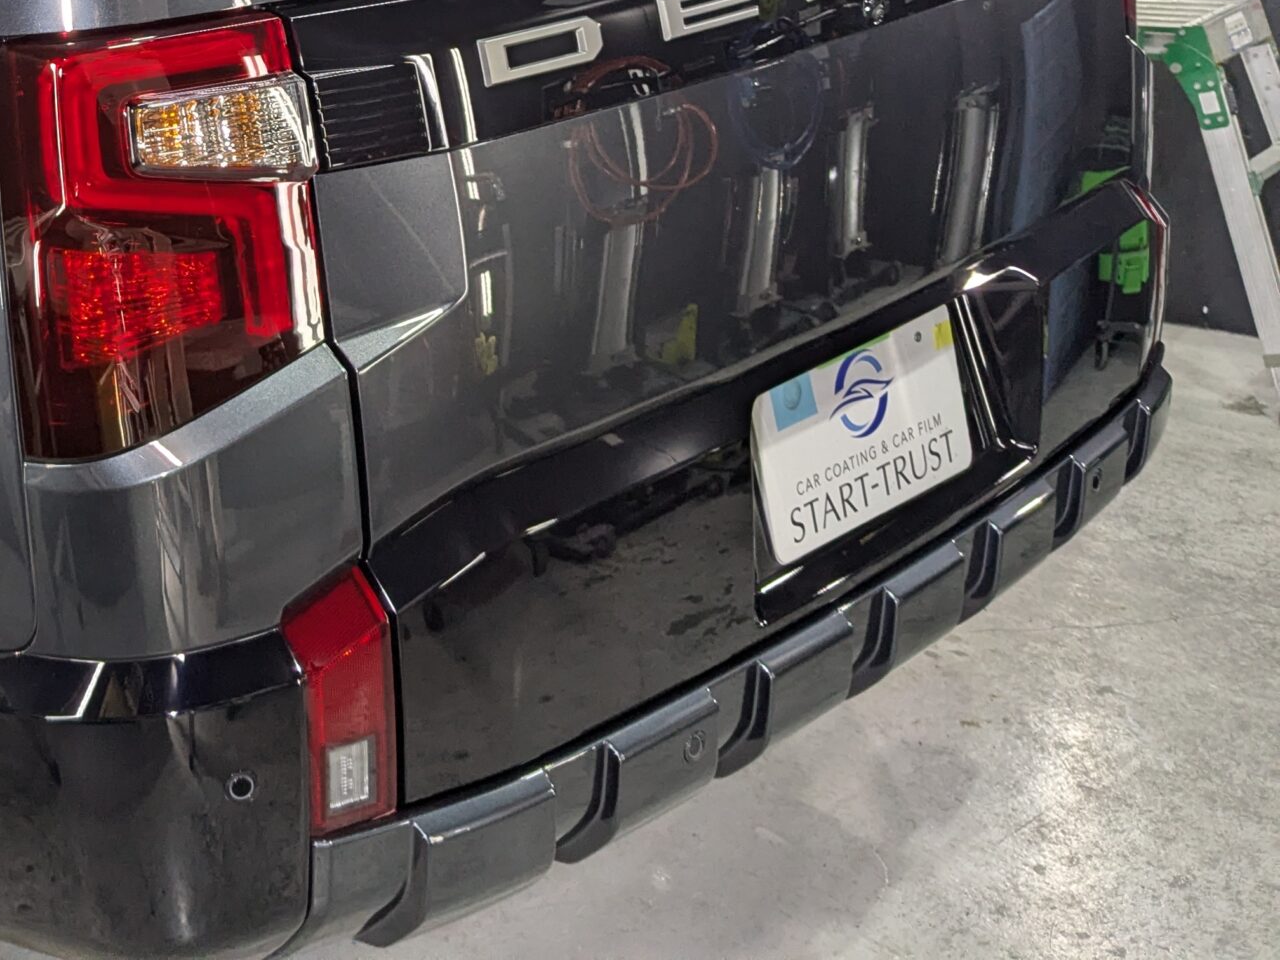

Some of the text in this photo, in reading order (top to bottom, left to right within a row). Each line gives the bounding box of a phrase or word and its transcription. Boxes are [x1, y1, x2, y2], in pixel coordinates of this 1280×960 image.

[789, 429, 954, 544] START-TRUST
[795, 412, 943, 496] CAR COATING & CAR FILM
